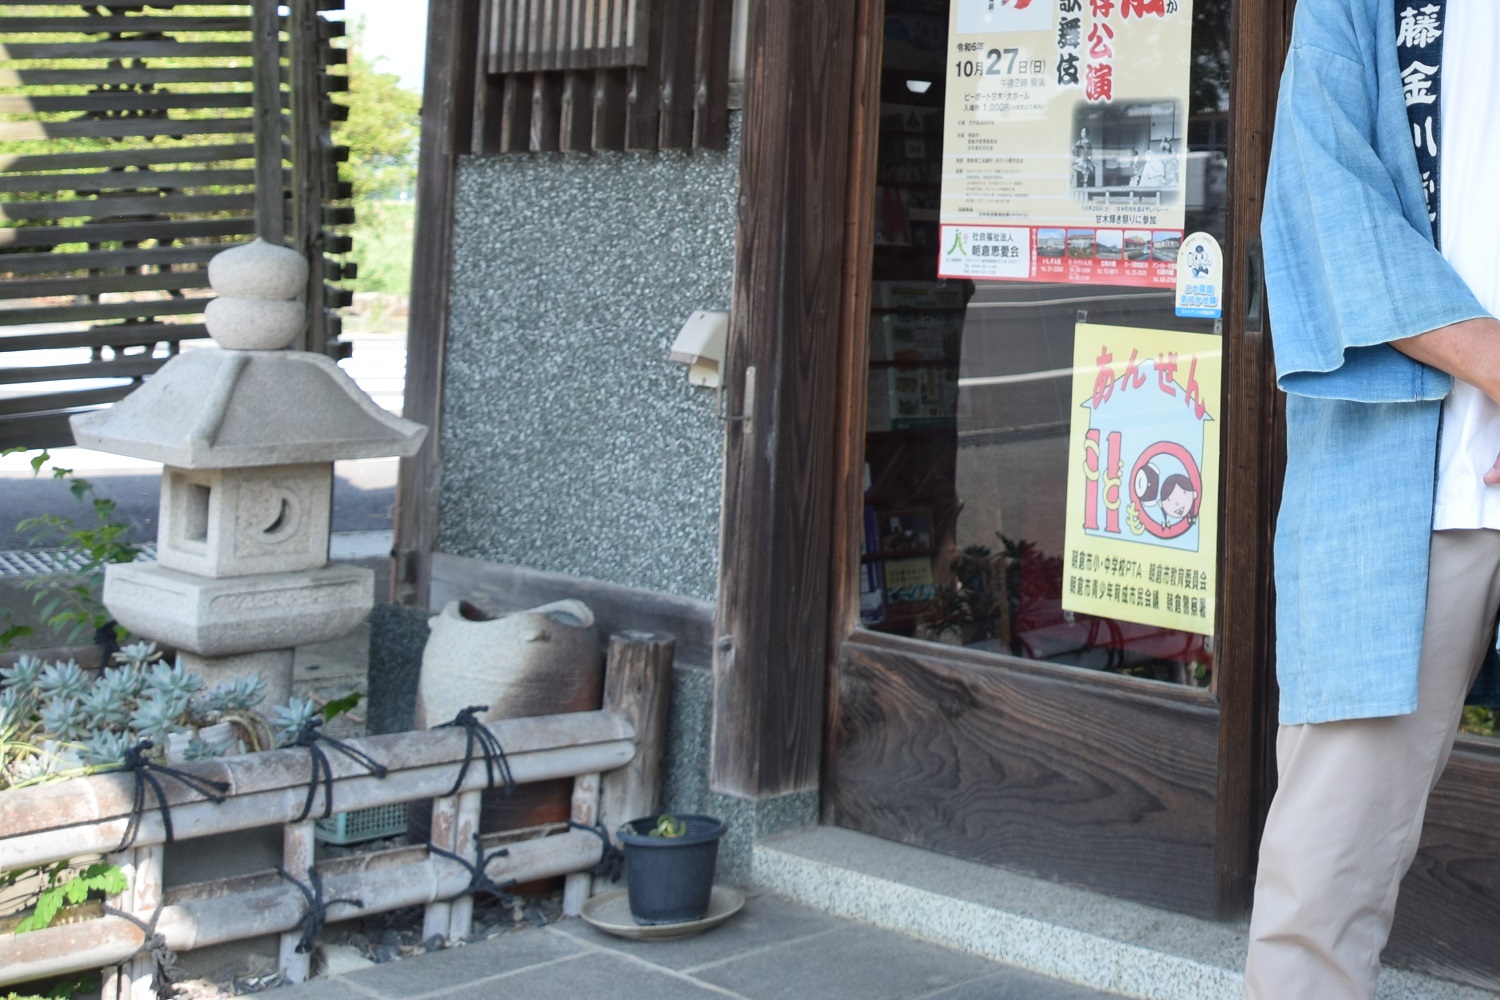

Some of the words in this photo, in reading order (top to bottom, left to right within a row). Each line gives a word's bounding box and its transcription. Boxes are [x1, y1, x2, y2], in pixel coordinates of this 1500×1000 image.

[957, 42, 984, 52] 令和6年
[1095, 214, 1157, 225] 甘木輝き祭りに参加
[972, 232, 1014, 242] 社会福祉法人
[971, 245, 1020, 258] 朝倉恵愛会
[1092, 345, 1206, 420] あんぜん
[1071, 550, 1143, 579] 朝倉市小・中学校PTA
[1148, 563, 1207, 591] 朝倉市教育委員会
[1069, 575, 1160, 610] 朝倉市青少年育成市民会議
[1166, 593, 1207, 618] 朝倉警察署
